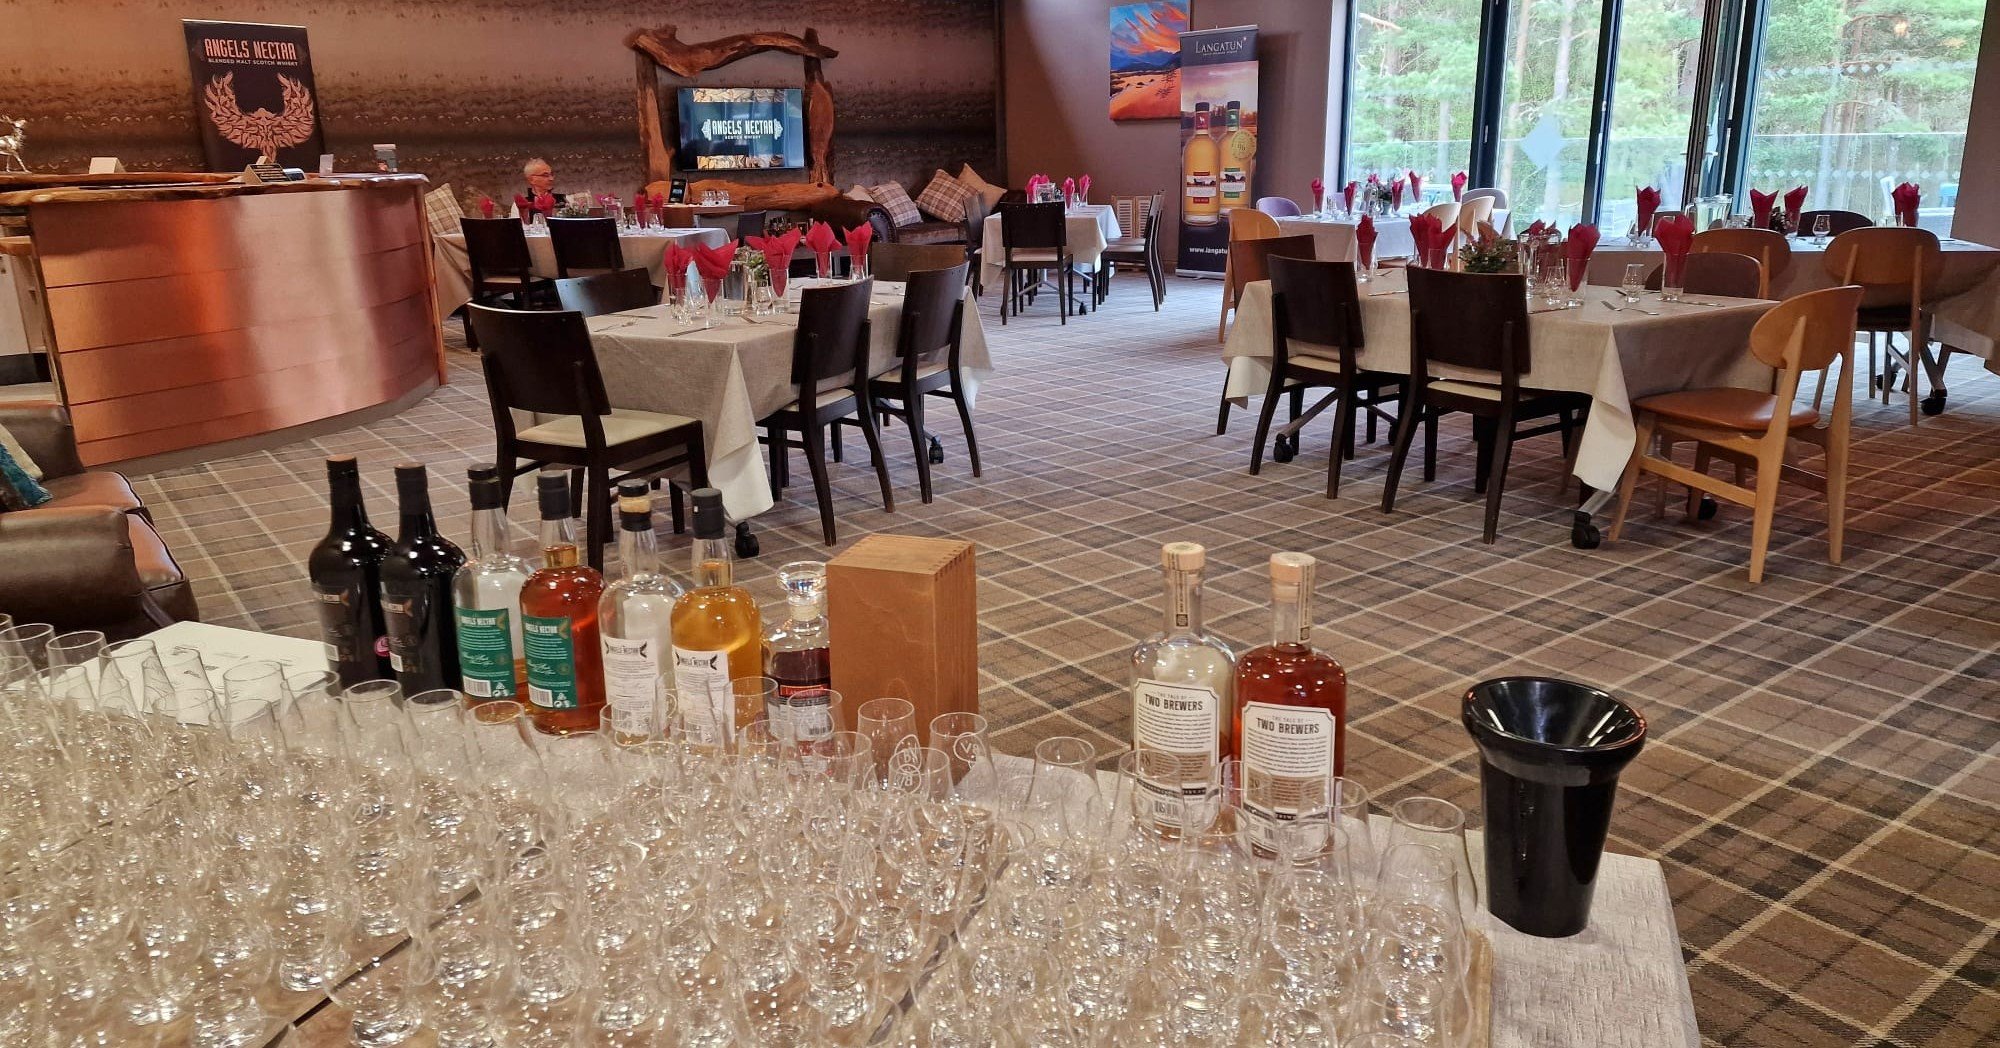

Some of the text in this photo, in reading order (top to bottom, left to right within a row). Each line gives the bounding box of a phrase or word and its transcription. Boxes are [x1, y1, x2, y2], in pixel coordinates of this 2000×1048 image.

[204, 38, 297, 60] ANGELS NECTAR
[1195, 40, 1243, 54] LANGATUN
[711, 120, 774, 135] ANGELS NECTAR
[1144, 693, 1204, 711] TWO BREWERS
[1256, 717, 1320, 735] TWO BREWERS
